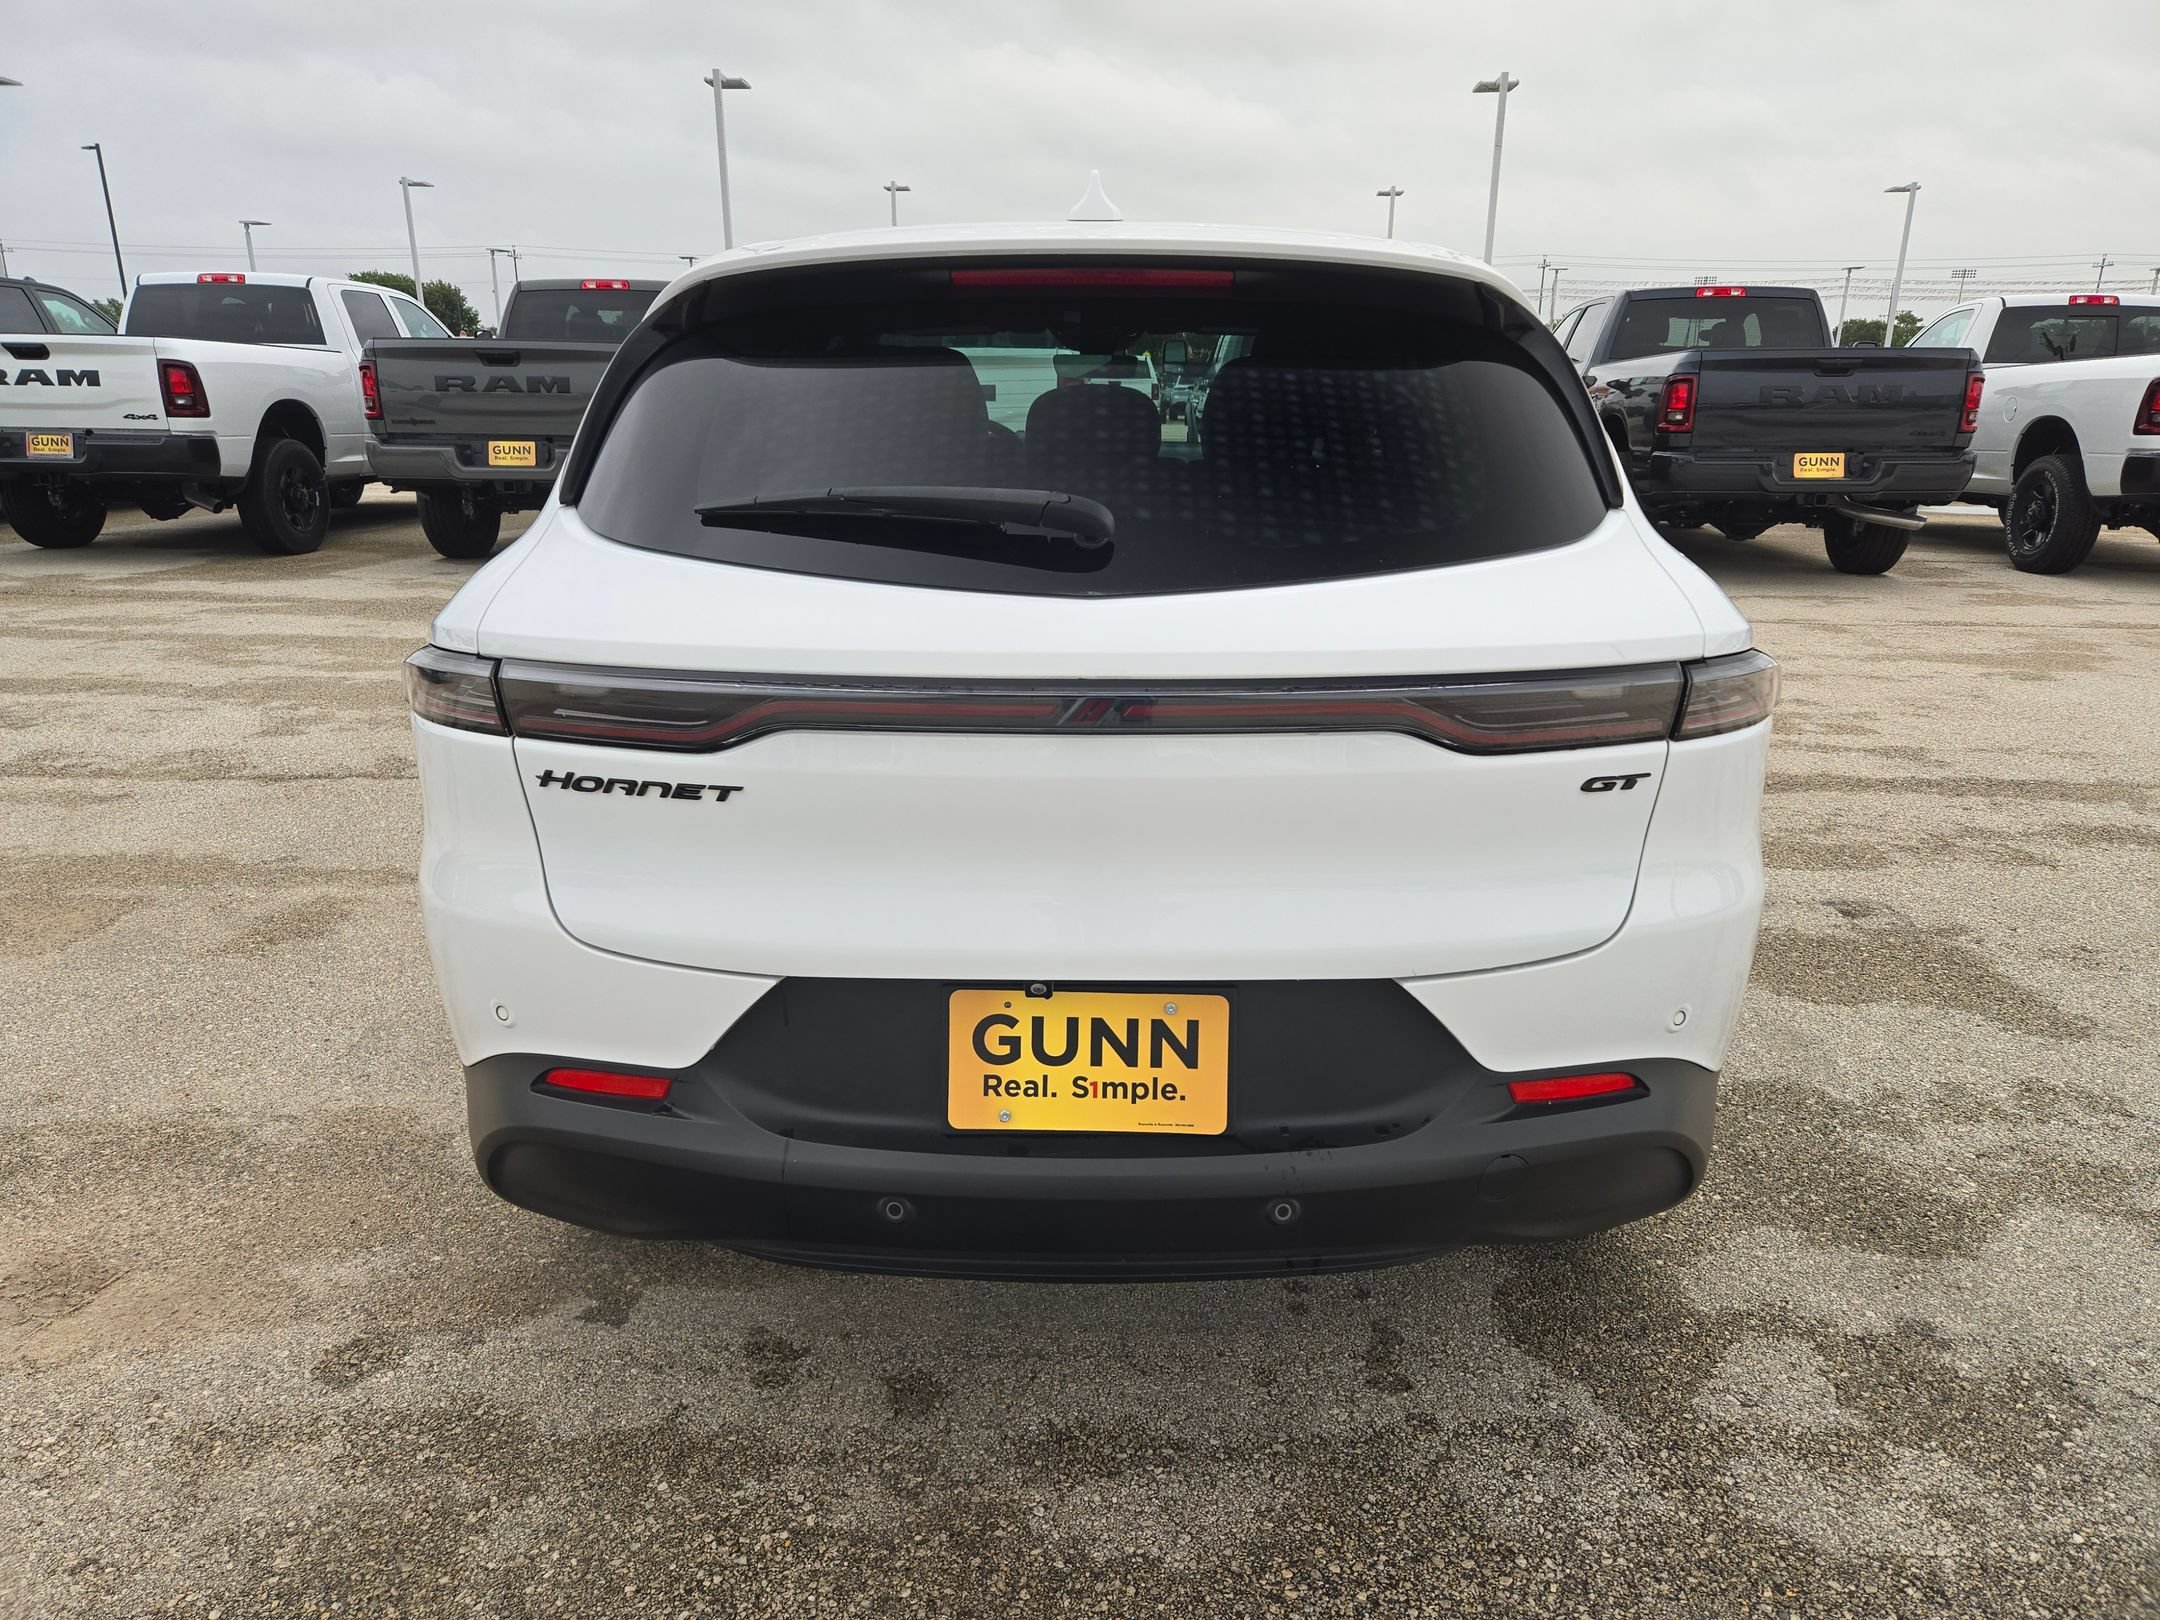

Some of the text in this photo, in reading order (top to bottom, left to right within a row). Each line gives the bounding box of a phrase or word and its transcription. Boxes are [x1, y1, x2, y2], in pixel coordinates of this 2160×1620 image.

[0, 369, 102, 387] AM
[434, 375, 571, 394] RAM
[1759, 384, 1904, 403] RAM
[31, 436, 69, 447] GUNN
[492, 445, 531, 455] GUNN
[1798, 457, 1840, 467] GUNN
[535, 769, 744, 802] HORNET
[1580, 772, 1651, 792] GT
[971, 1013, 1199, 1070] GUNN
[982, 1074, 1186, 1104] Real. S1mple.
